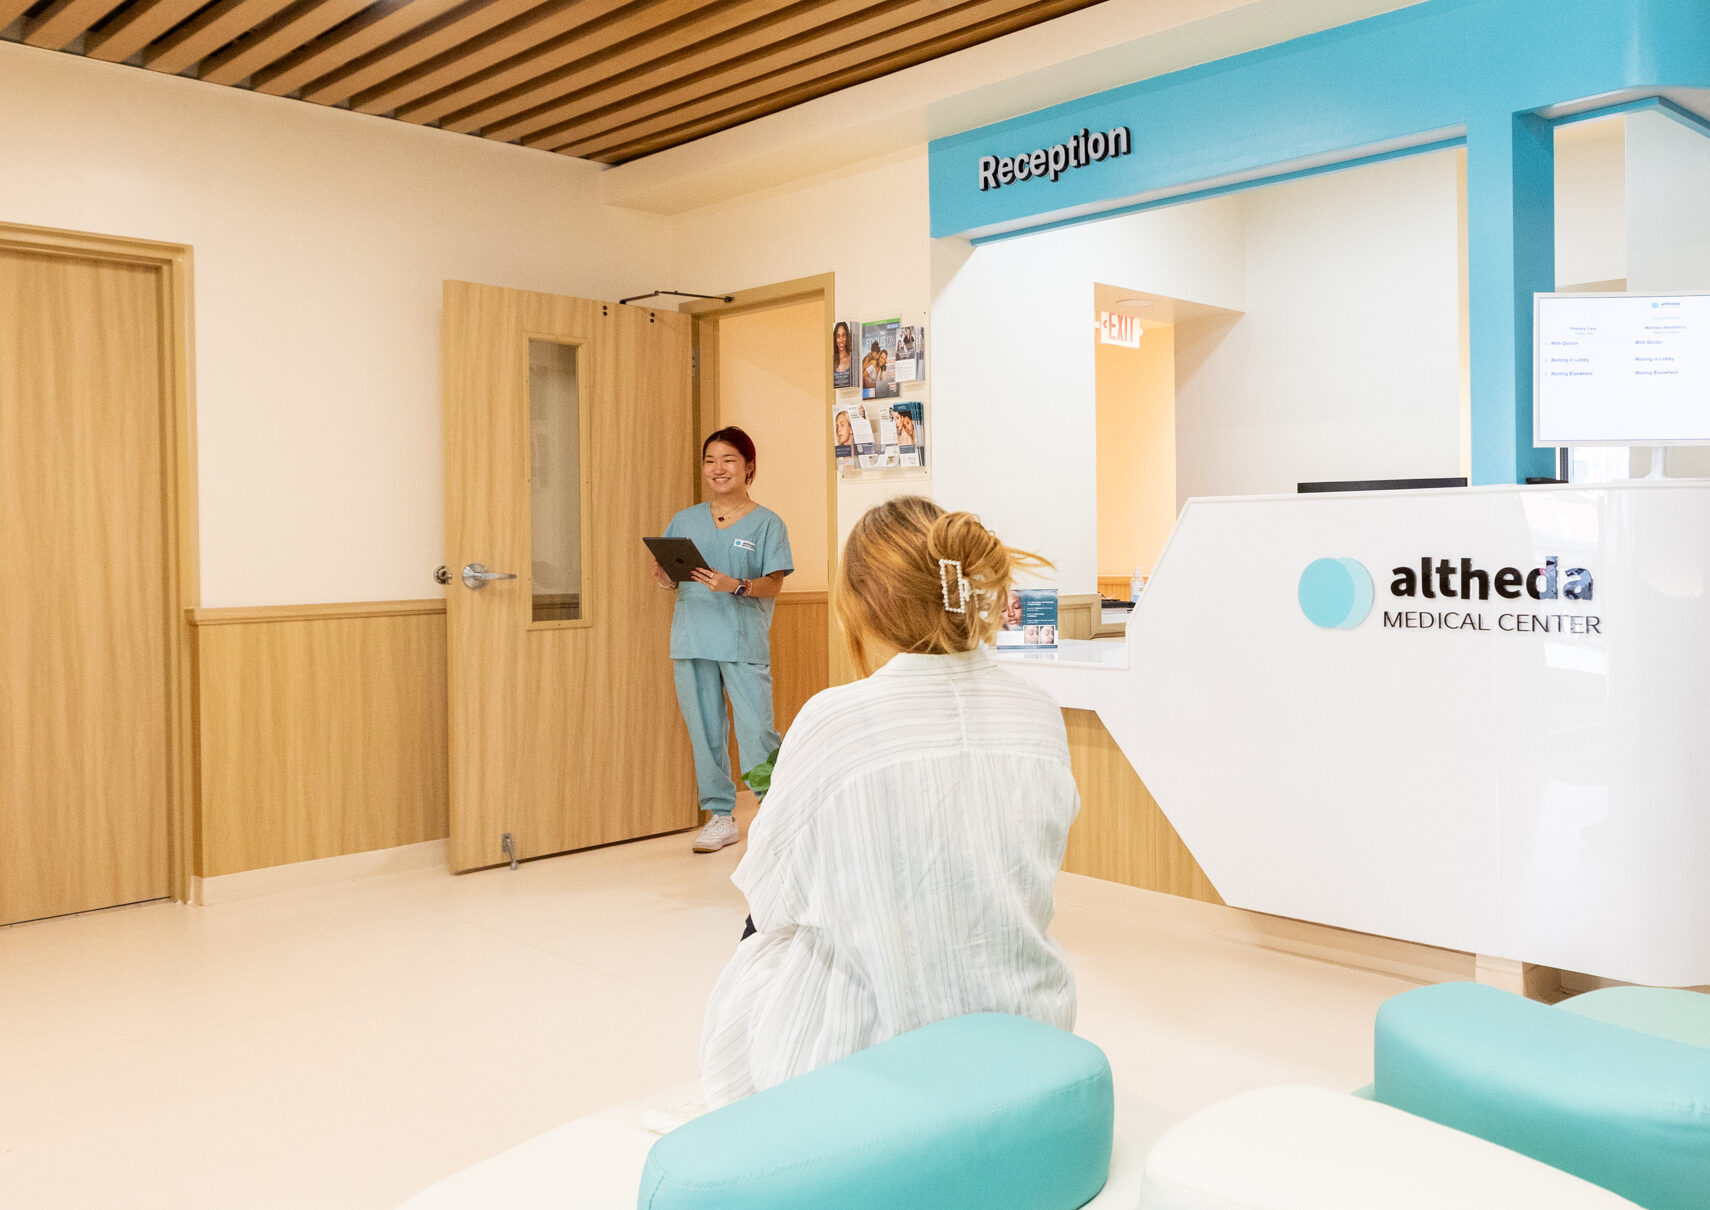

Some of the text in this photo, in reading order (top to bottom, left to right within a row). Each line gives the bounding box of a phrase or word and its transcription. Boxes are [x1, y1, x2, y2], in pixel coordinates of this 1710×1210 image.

[979, 126, 1132, 191] Reception
[1109, 312, 1135, 343] EXIT
[1391, 555, 1593, 600] altheda
[1383, 611, 1603, 634] MEDICAL CENTER
